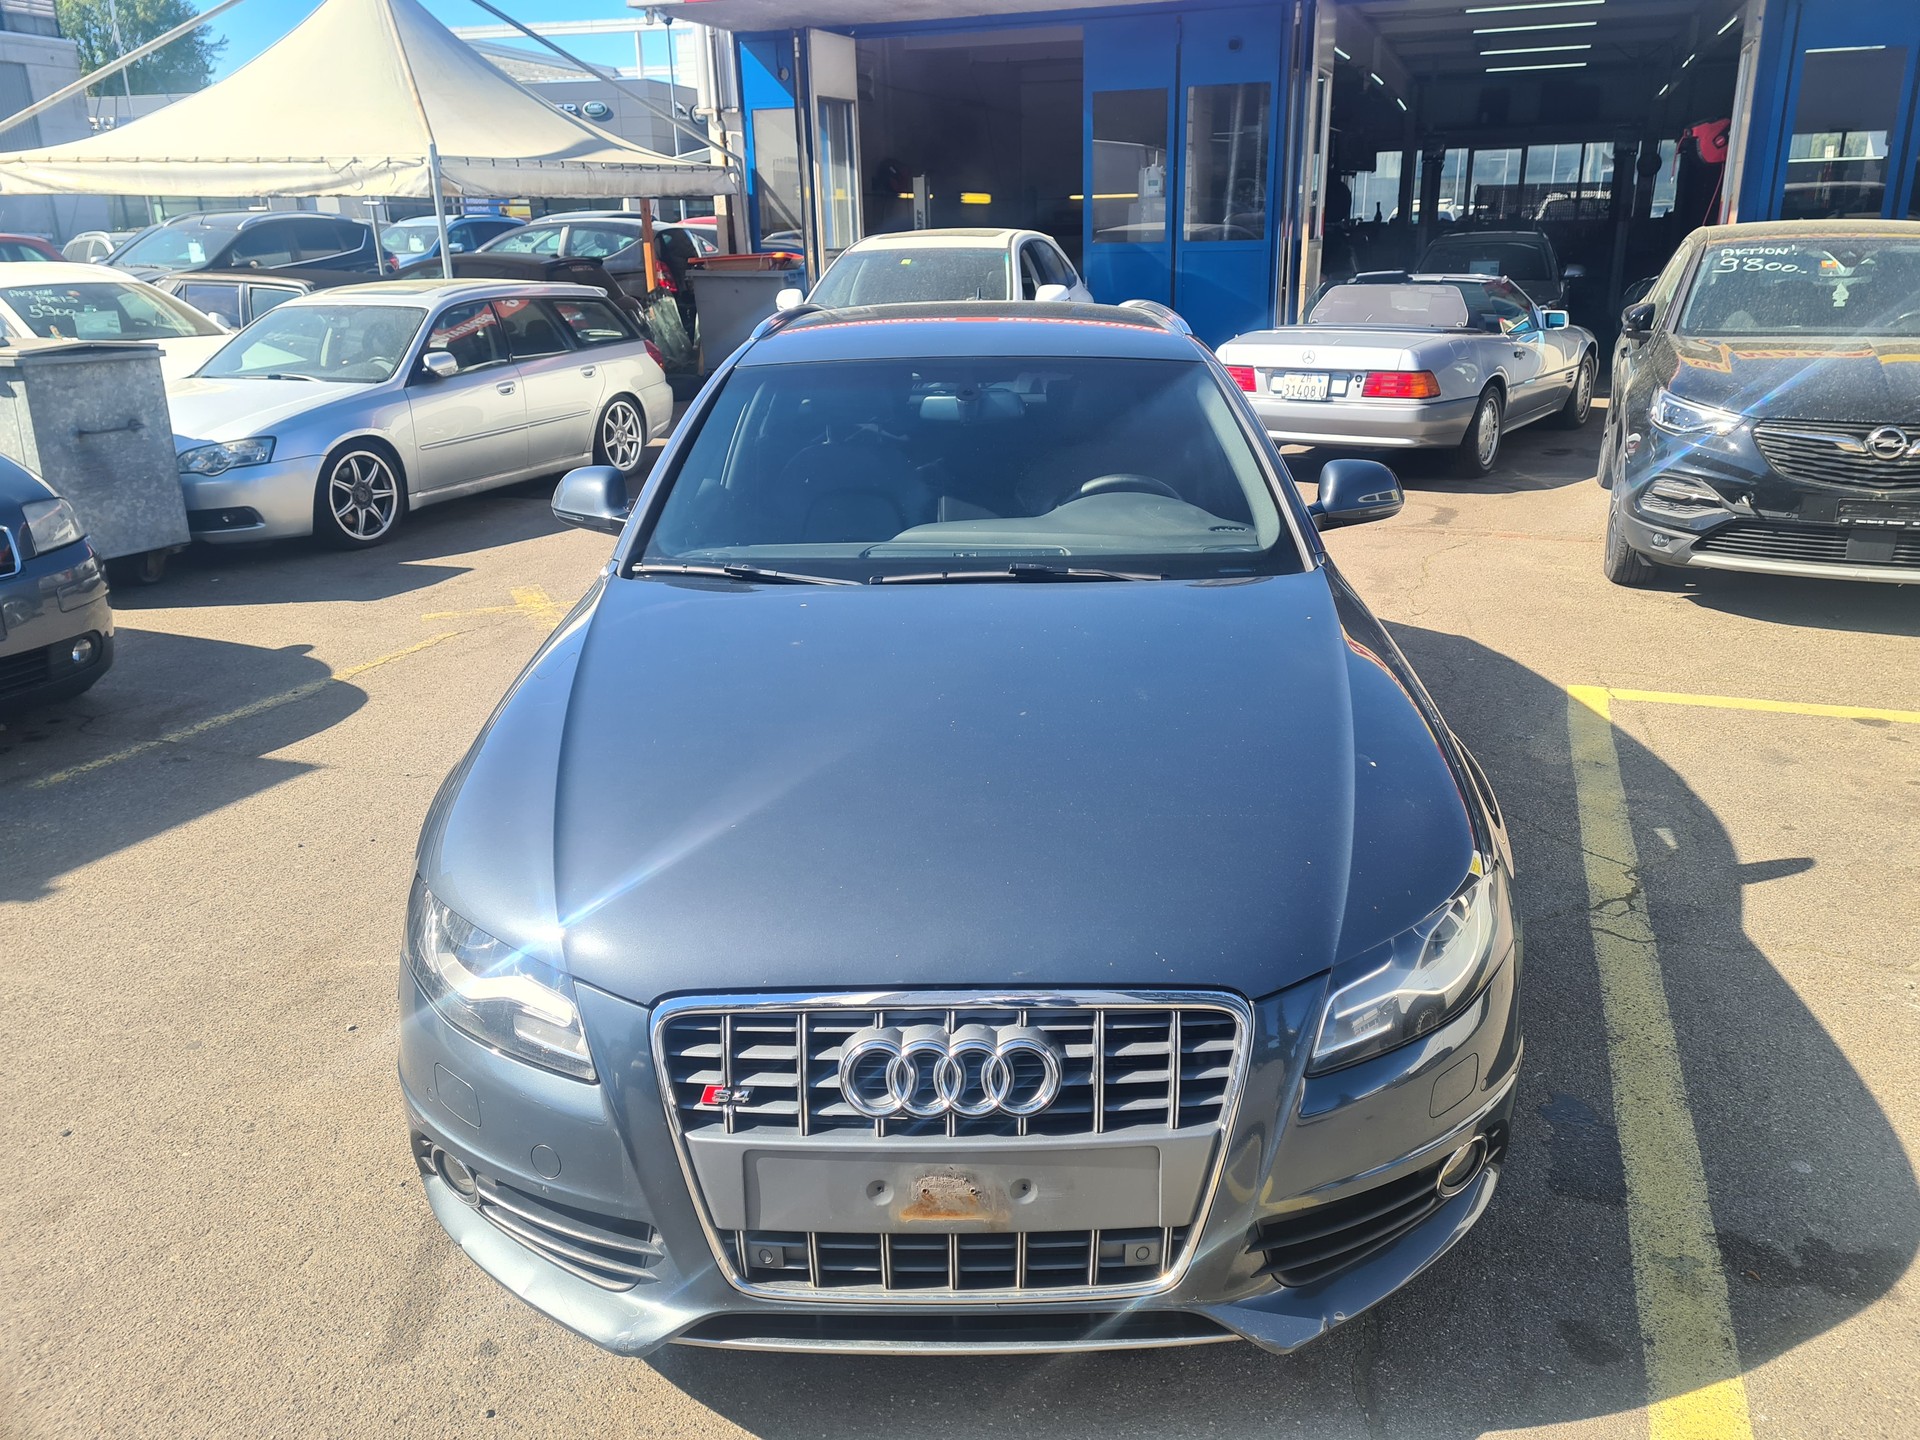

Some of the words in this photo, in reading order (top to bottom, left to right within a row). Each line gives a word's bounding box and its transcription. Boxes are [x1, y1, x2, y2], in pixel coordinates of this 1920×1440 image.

[1721, 244, 1798, 257] AKTION!
[1300, 373, 1313, 384] ZH
[1283, 383, 1317, 397] 31408
[1318, 385, 1326, 398] U
[711, 1088, 750, 1103] S4
